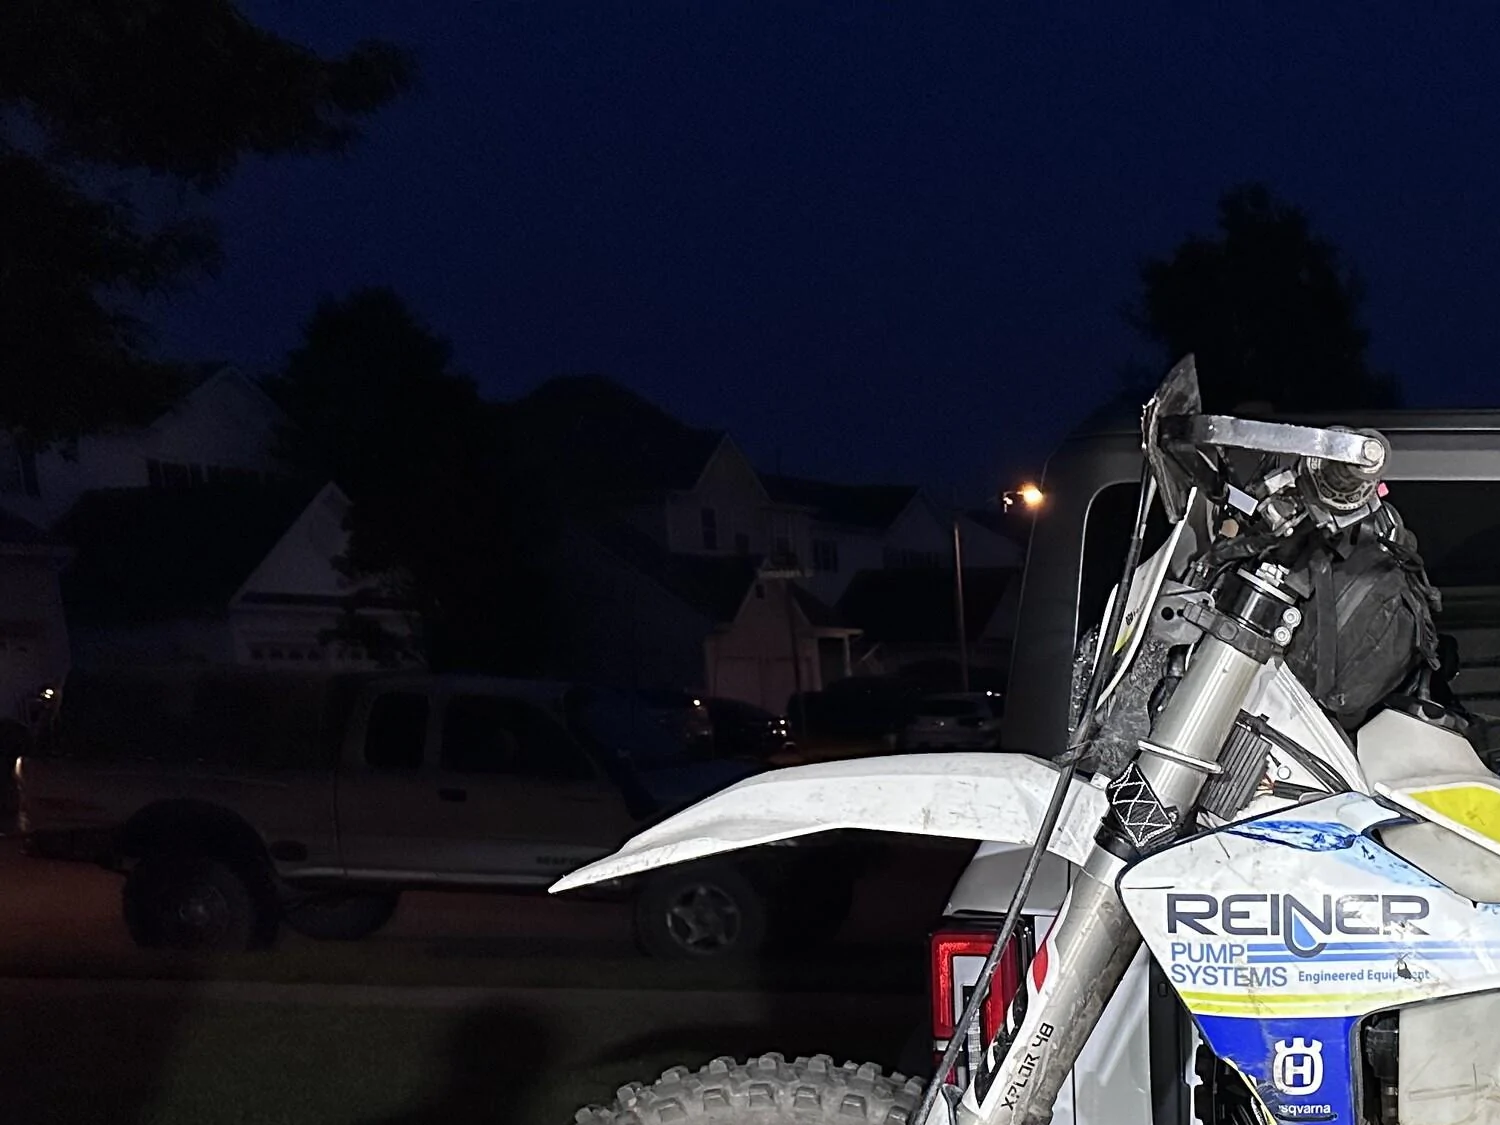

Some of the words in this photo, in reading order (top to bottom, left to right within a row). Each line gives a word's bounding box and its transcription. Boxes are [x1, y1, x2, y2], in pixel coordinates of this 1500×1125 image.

[1166, 892, 1430, 957] REINER
[1170, 942, 1245, 964] PUMP
[1170, 965, 1288, 988] SYSTEMS
[1298, 969, 1364, 986] Engineered
